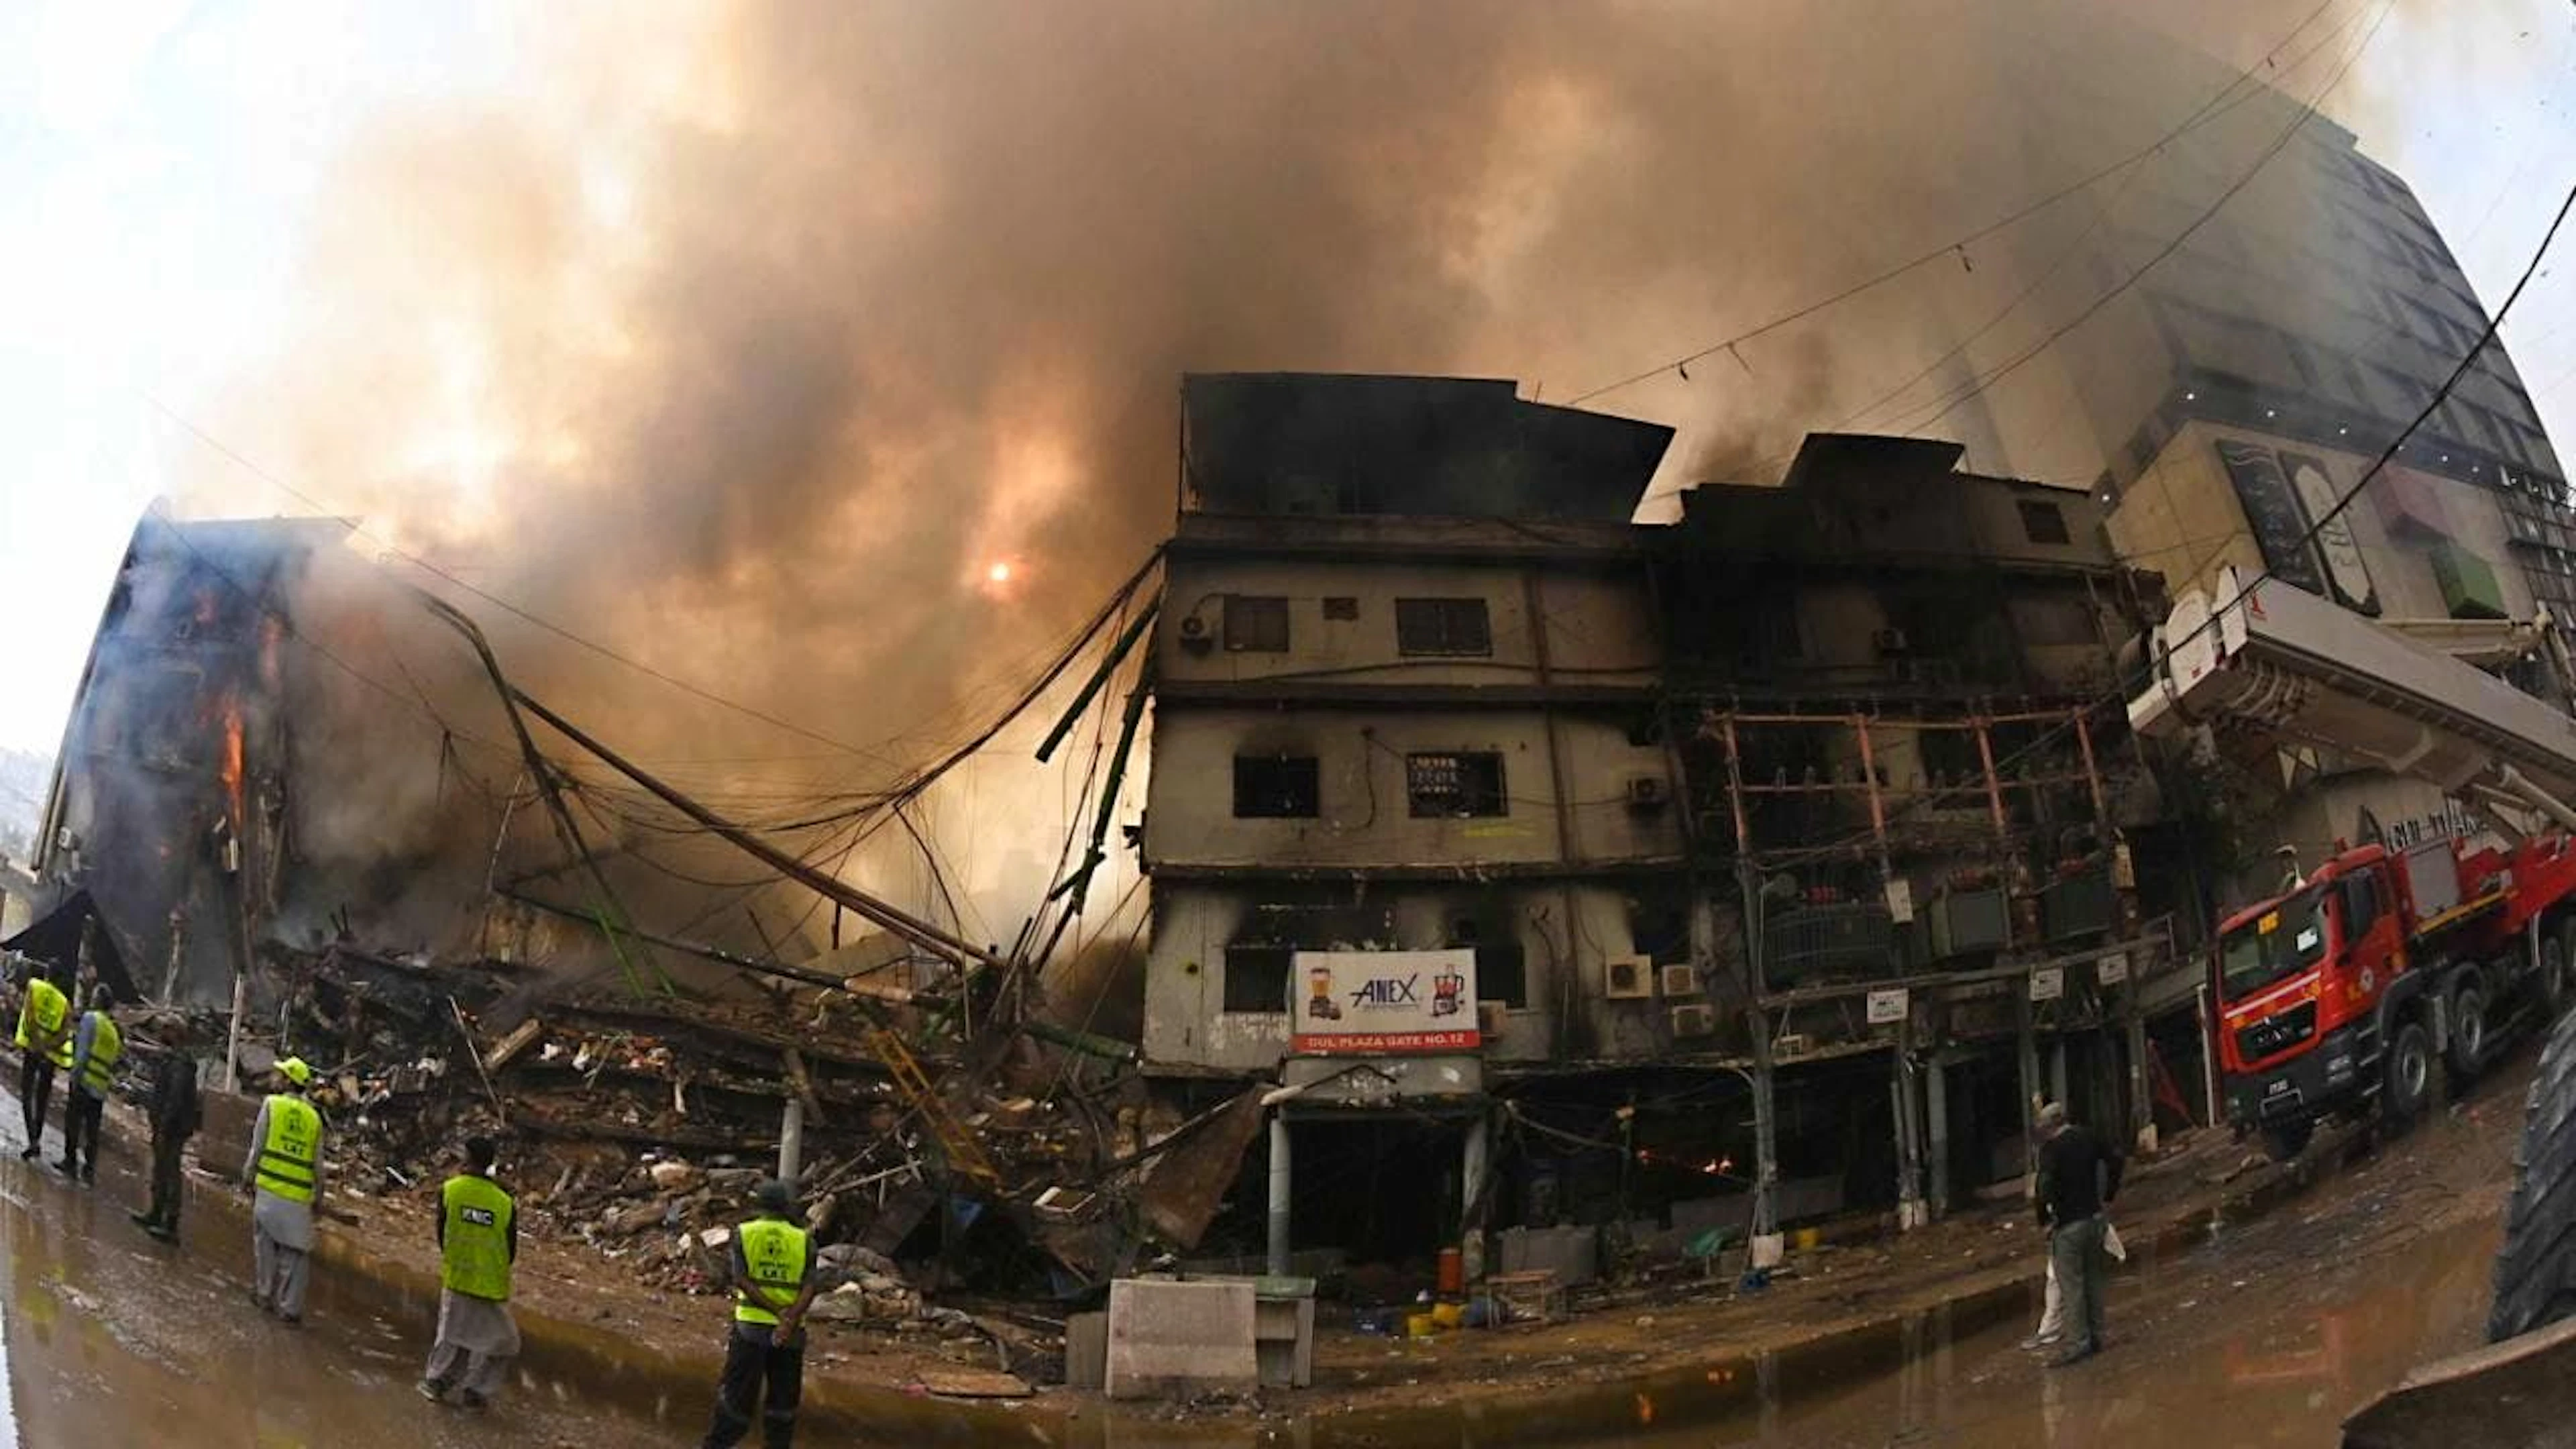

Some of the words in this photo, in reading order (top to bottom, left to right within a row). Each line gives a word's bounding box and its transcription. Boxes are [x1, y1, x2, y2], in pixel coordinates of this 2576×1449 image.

[1349, 972, 1419, 1008] ANEX
[1339, 1036, 1384, 1047] PLAZA
[1387, 1035, 1422, 1046] GATE
[1450, 1032, 1464, 1044] 12
